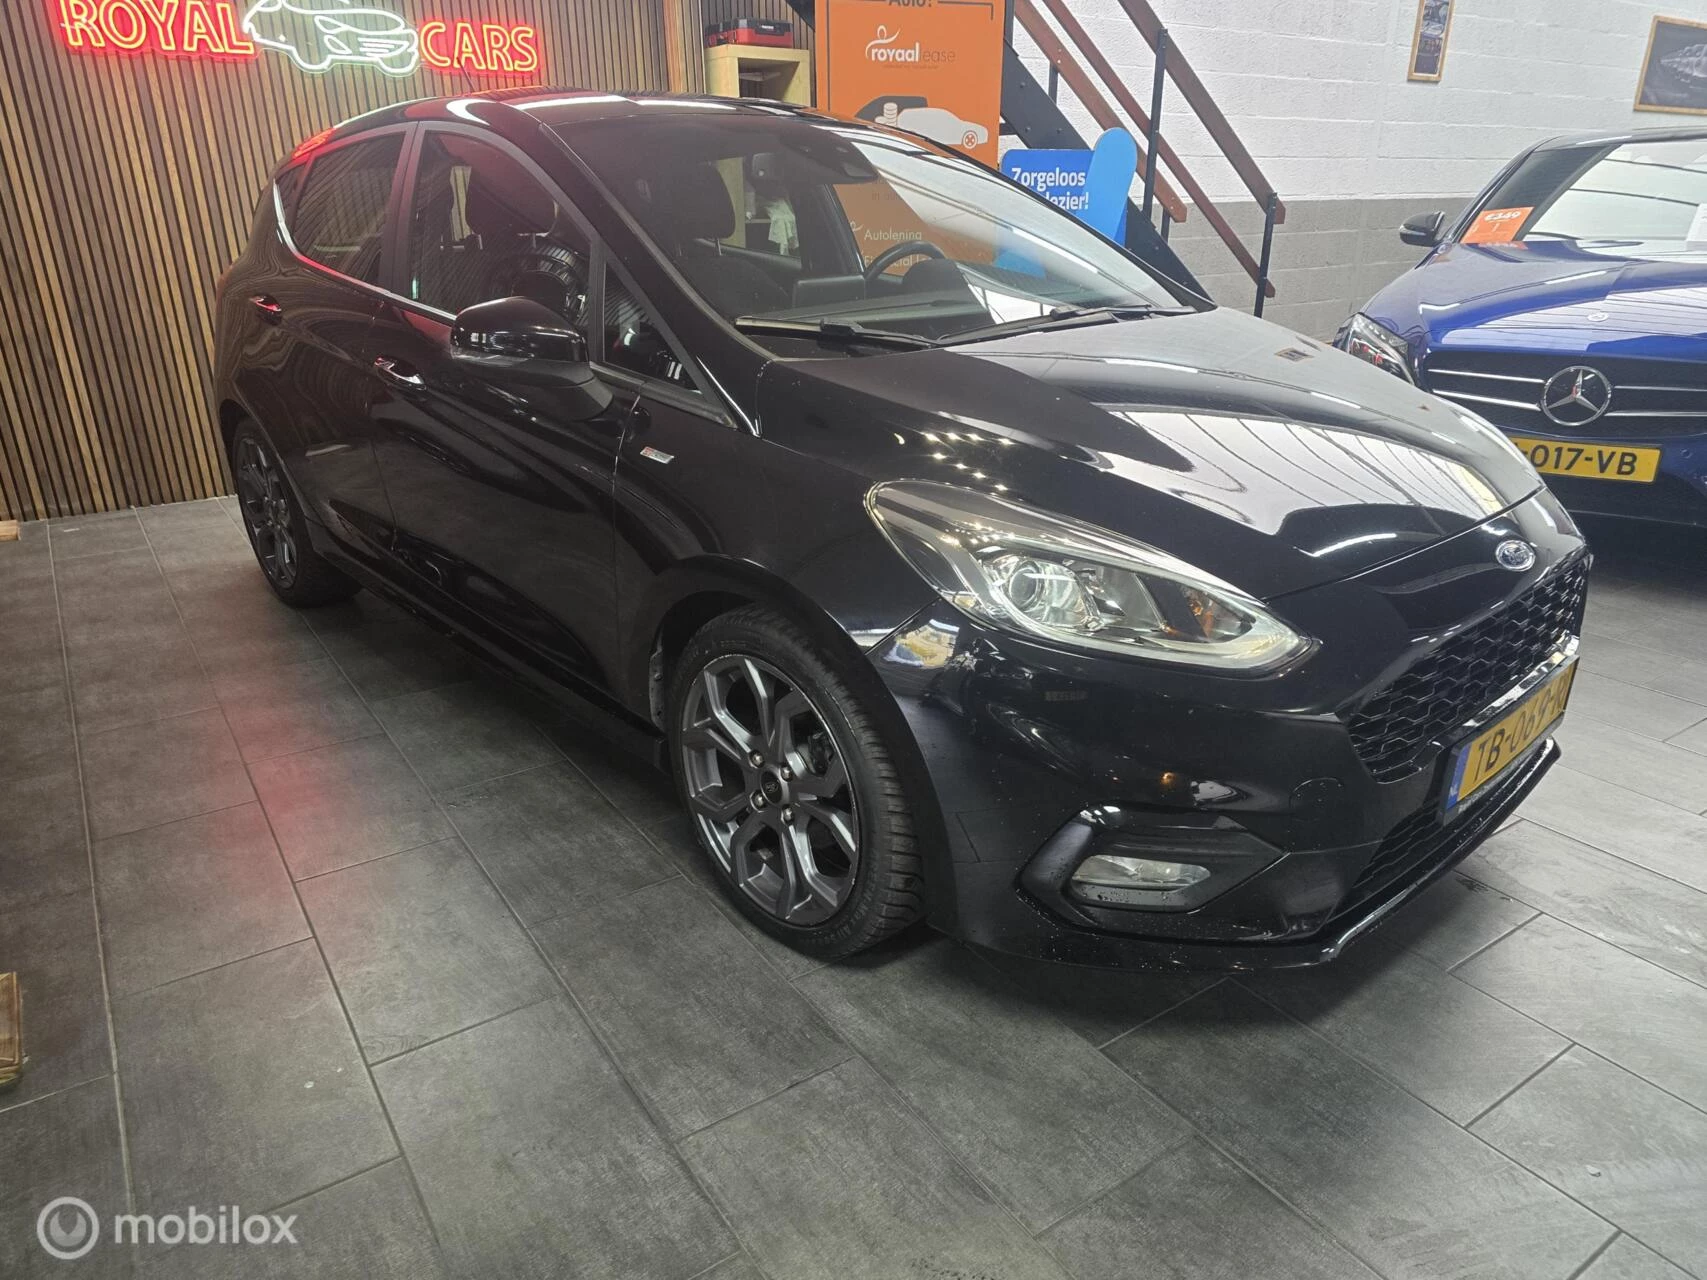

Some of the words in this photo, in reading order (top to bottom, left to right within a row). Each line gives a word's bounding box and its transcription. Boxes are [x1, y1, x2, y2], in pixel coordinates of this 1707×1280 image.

[61, 0, 254, 54] ROYAL
[420, 21, 538, 71] CARS
[871, 42, 919, 62] royaal
[1011, 167, 1086, 191] Zorgeloos
[1514, 443, 1637, 475] -017-VB
